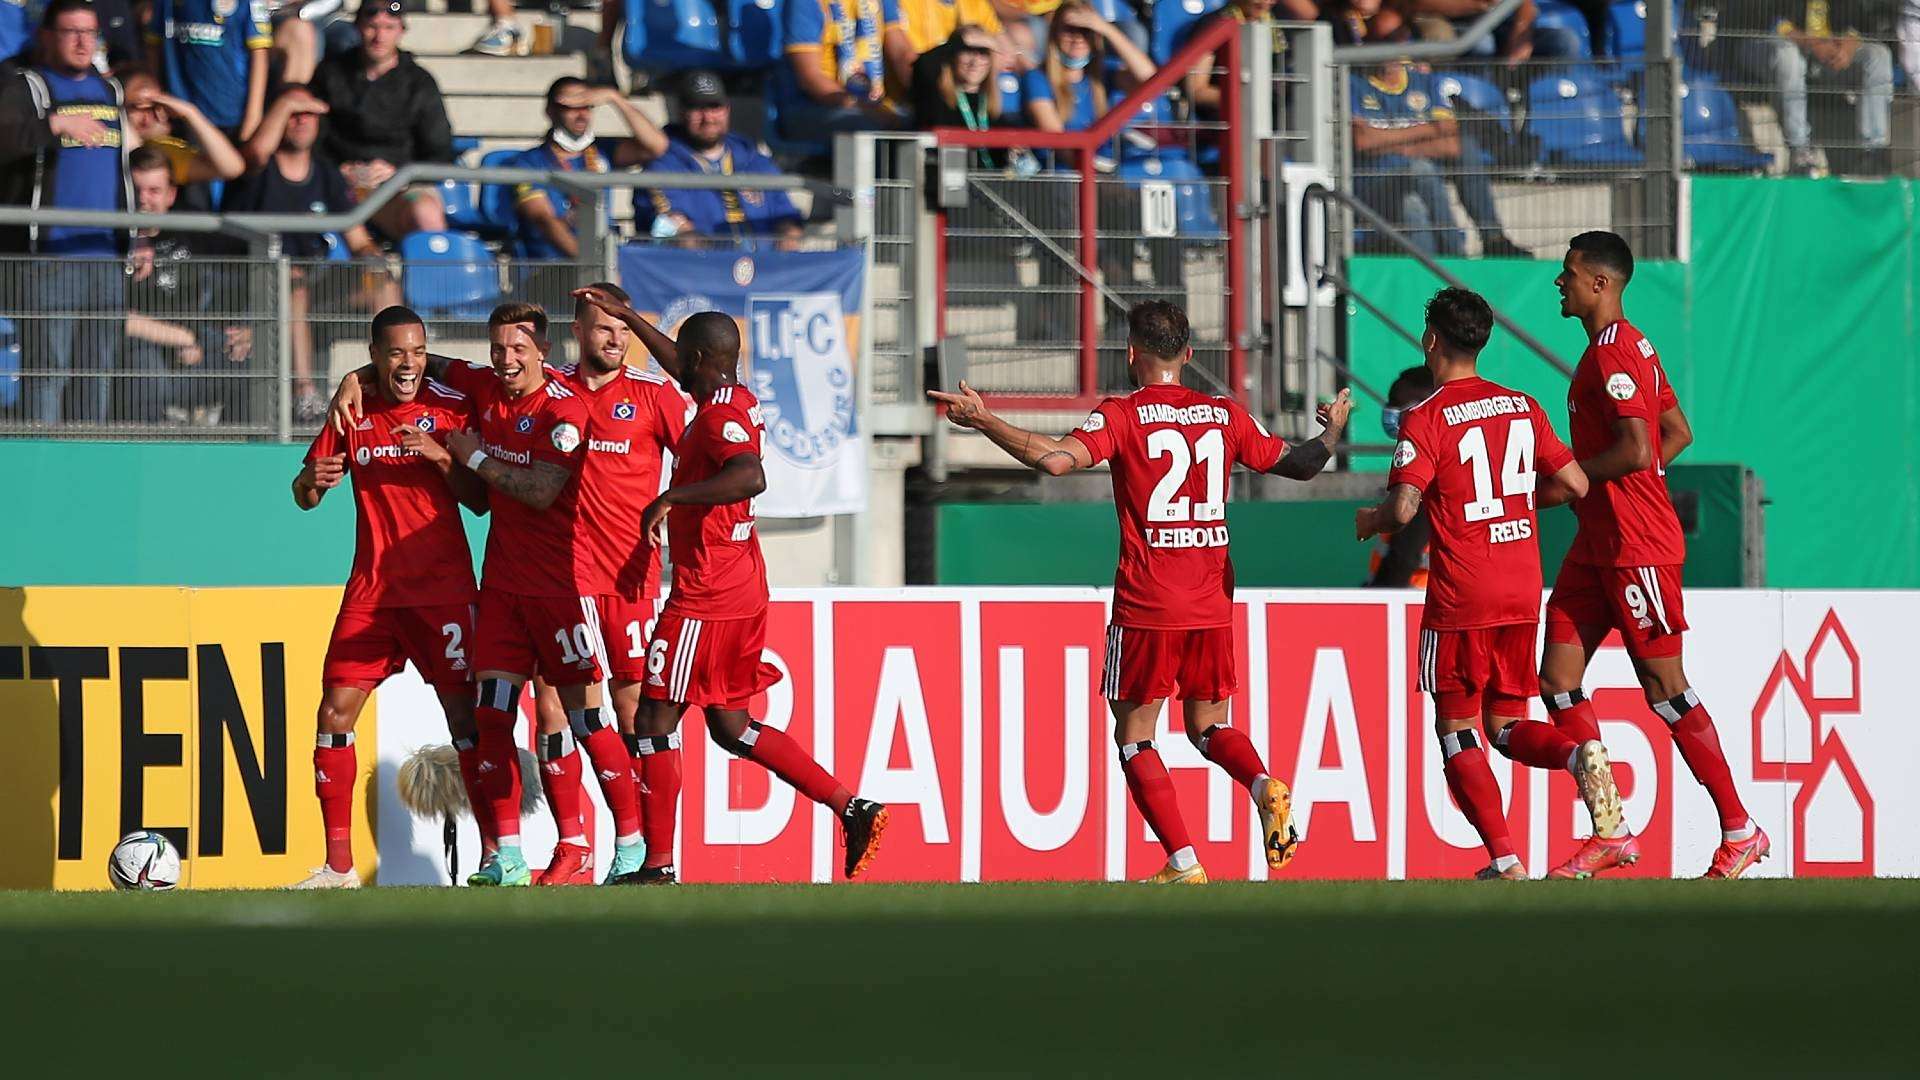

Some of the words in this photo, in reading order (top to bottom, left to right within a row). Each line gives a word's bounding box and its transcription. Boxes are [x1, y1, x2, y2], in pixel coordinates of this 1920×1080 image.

[1137, 404, 1214, 425] HAMBURGER
[1213, 406, 1230, 425] SV
[1443, 396, 1515, 426] HAMBURGER
[1146, 428, 1225, 522] 21
[1457, 418, 1536, 523] 14
[1145, 525, 1230, 548] LEIBOLD
[1489, 518, 1532, 543] REIS
[1625, 584, 1647, 619] 9
[442, 623, 465, 659] 2
[555, 623, 594, 664] 10
[647, 639, 669, 675] 6
[0, 641, 287, 861] TEN
